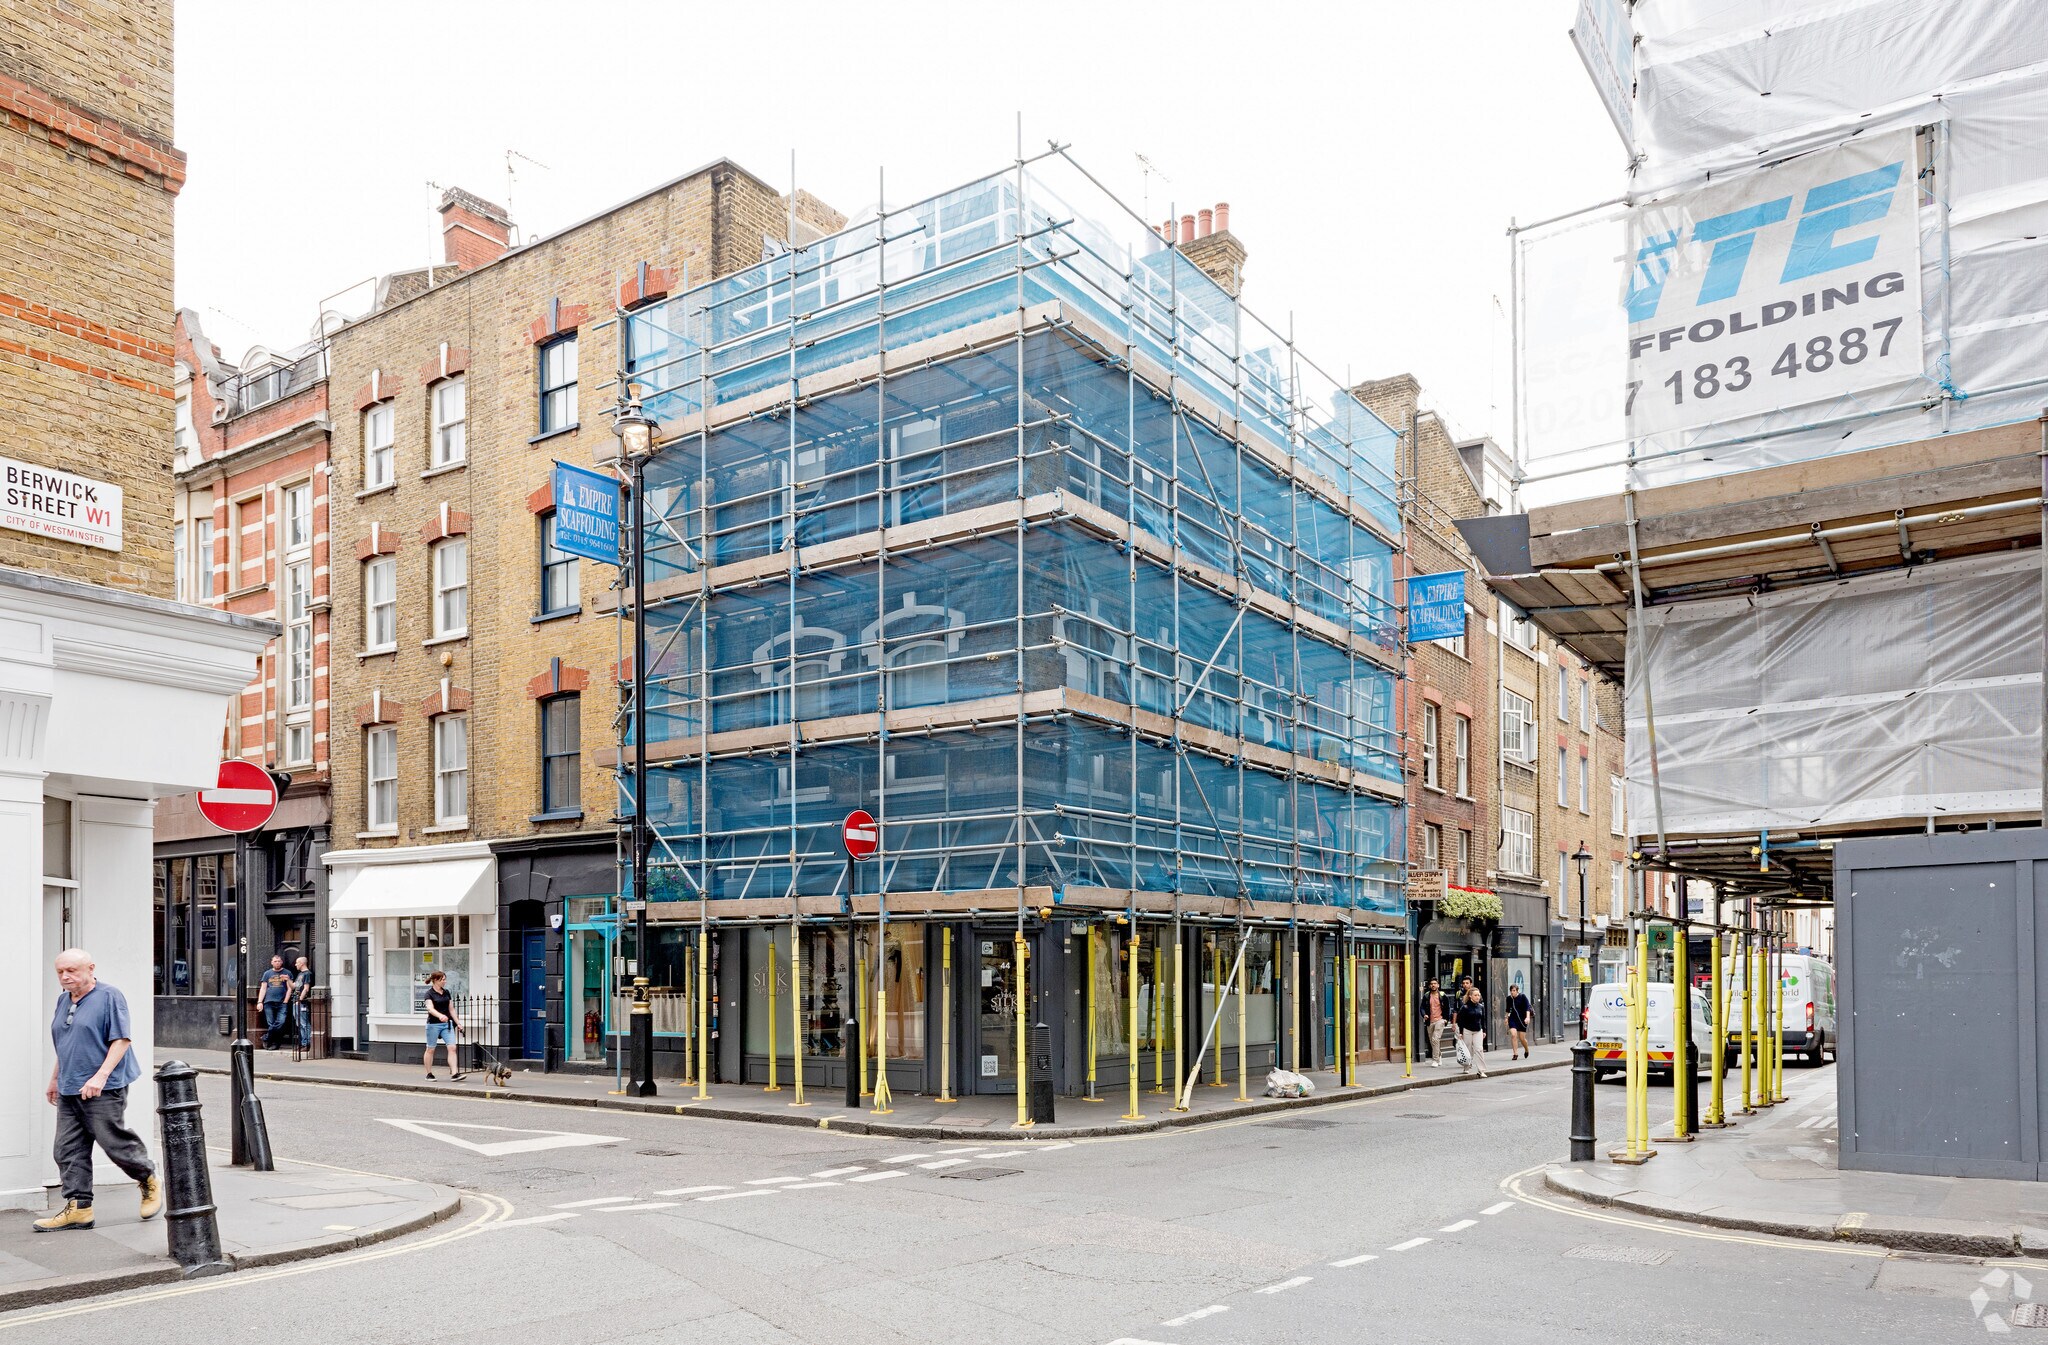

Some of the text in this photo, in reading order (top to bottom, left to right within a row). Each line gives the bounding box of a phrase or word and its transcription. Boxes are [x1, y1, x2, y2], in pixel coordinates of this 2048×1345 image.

[1664, 356, 1752, 405] 183
[1771, 316, 1904, 380] 4887
[7, 466, 97, 503] BERWICK
[7, 488, 110, 527] STREET W1
[578, 485, 613, 516] EMPIRE
[6, 515, 105, 544] CITY OF WESTMINSTER
[560, 507, 616, 542] SCAFFOLDING
[560, 530, 572, 541] Tel:
[1427, 582, 1459, 603] EMPIRE
[1411, 602, 1462, 626] SCAFFOLDING
[330, 918, 338, 929] 23
[240, 946, 248, 954] 6
[1000, 962, 1011, 970] 44
[753, 972, 788, 987] SIK
